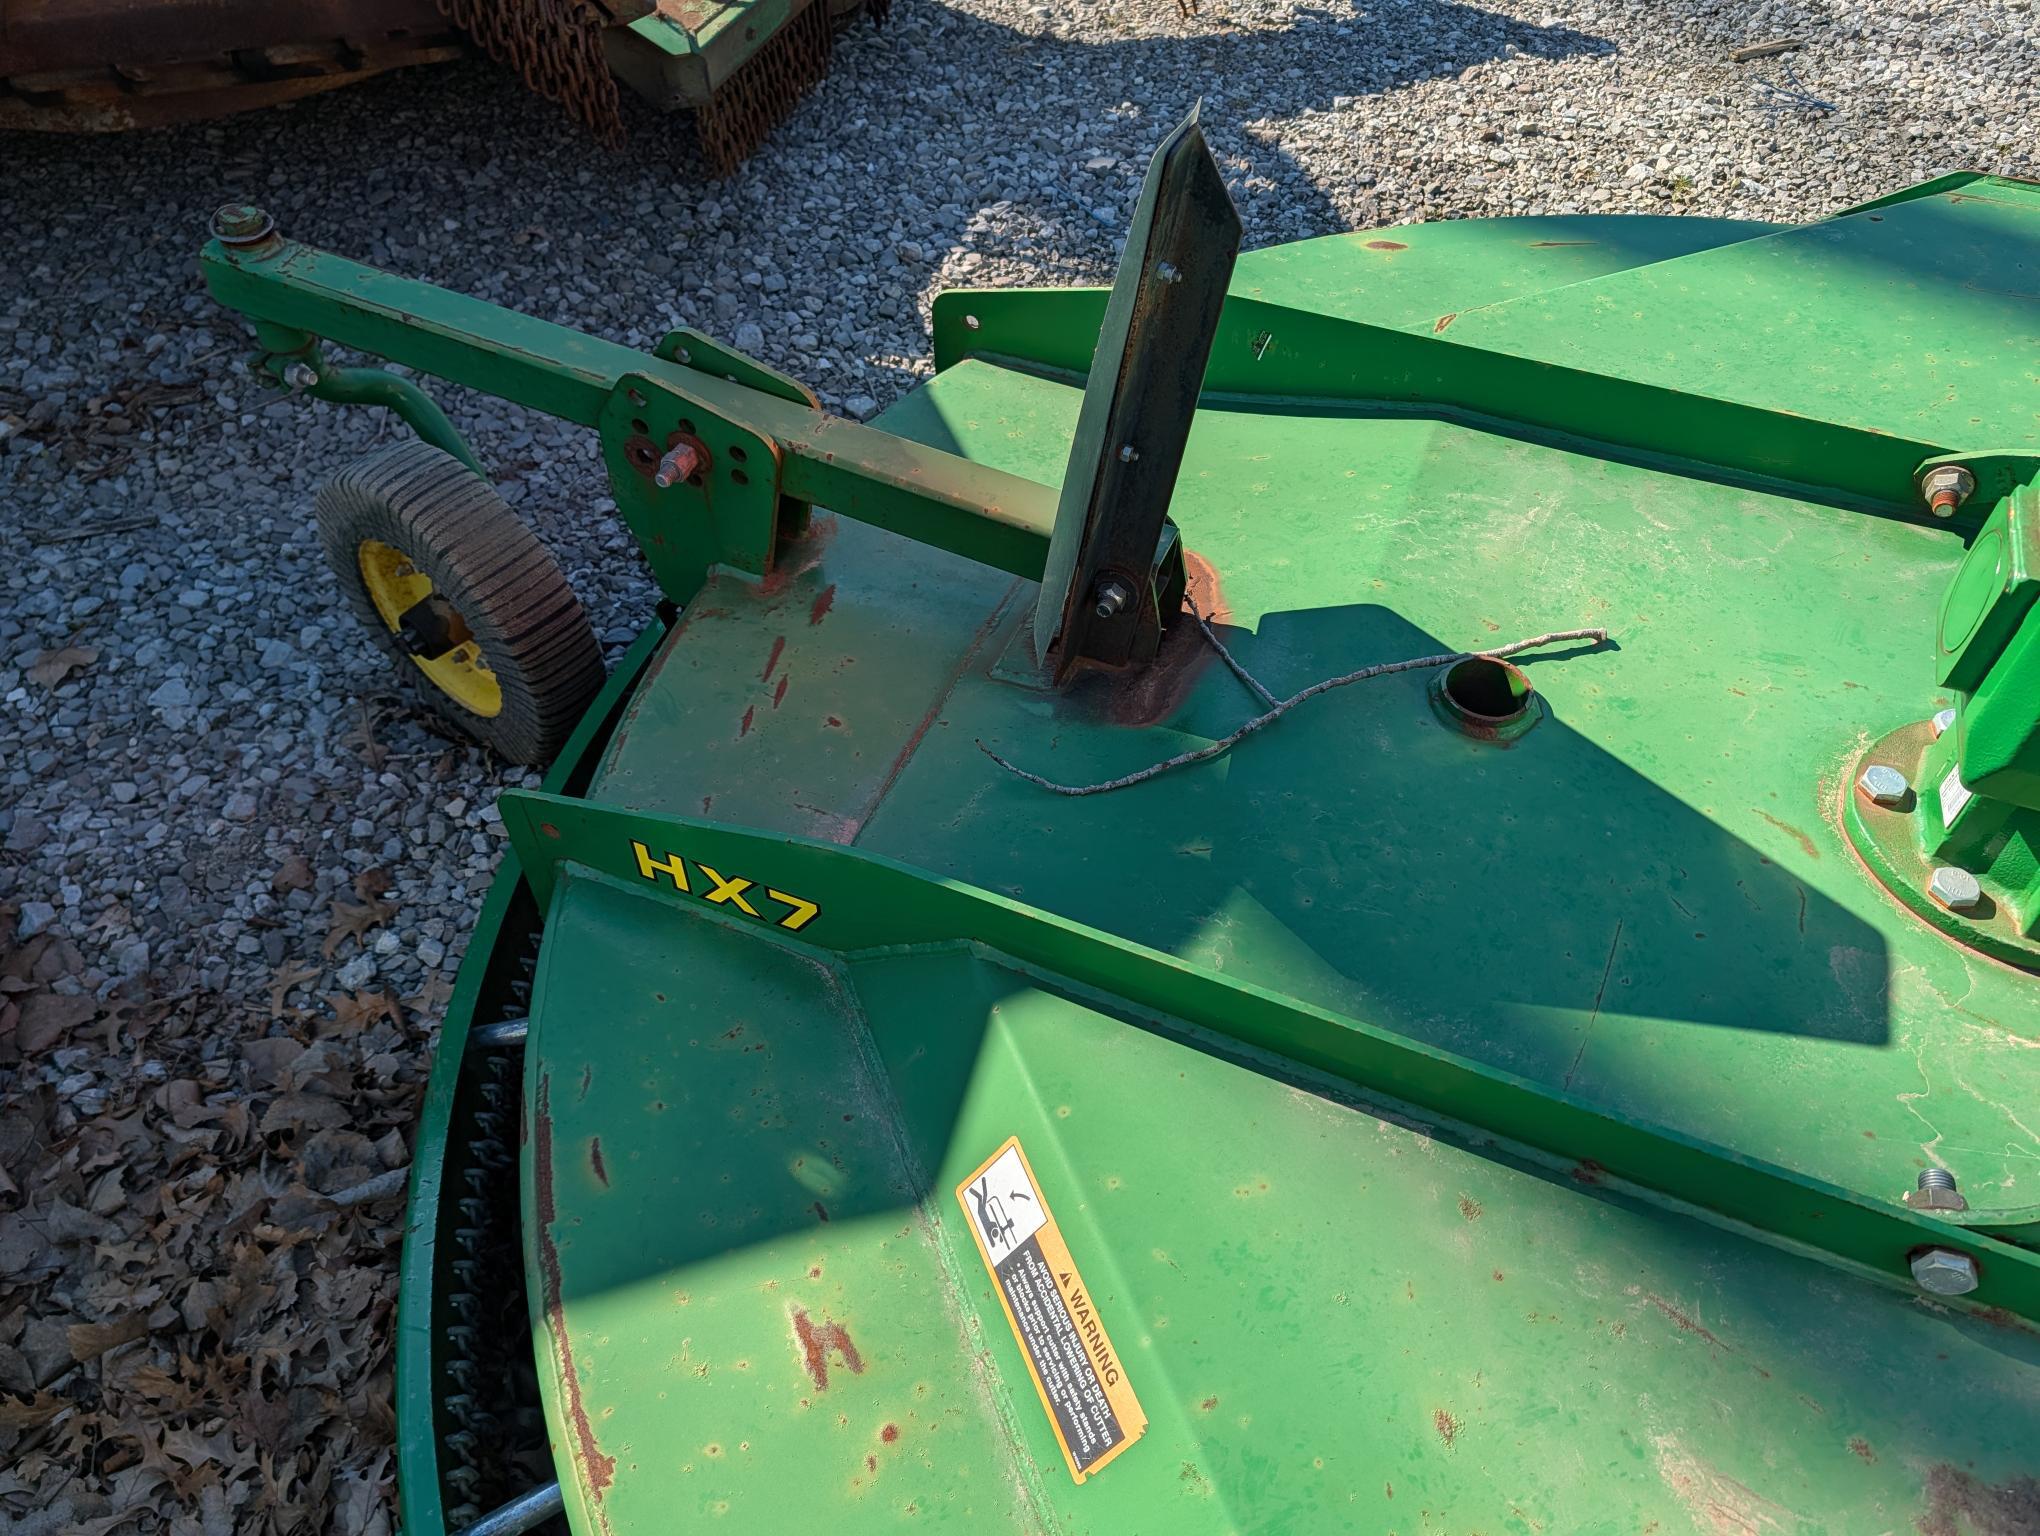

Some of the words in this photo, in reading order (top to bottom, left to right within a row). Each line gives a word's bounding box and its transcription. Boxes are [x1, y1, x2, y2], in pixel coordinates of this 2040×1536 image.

[629, 838, 822, 933] HX7
[1010, 1272, 1019, 1285] or
[1015, 1282, 1032, 1313] blocks
[1004, 1277, 1031, 1333] maintenance
[1027, 1331, 1043, 1360] under
[1038, 1358, 1050, 1376] the
[1045, 1374, 1062, 1407] cutter.
[1021, 1248, 1039, 1279] FROM
[1033, 1276, 1064, 1337] ACCIDENTAL
[1059, 1334, 1088, 1390] LOWERING
[1082, 1387, 1094, 1406] OF
[1089, 1403, 1113, 1448] CUTTER
[1027, 1311, 1041, 1336] prior
[1036, 1259, 1054, 1290] AVOID
[1048, 1287, 1073, 1333] SERIOUS
[1067, 1330, 1088, 1368] INJURY
[1083, 1365, 1096, 1384] OR
[1090, 1382, 1111, 1420] DEATH
[1037, 1334, 1046, 1347] to
[1067, 1287, 1121, 1388] WARNING
[1016, 1266, 1035, 1300] Always
[1029, 1297, 1050, 1335] support
[1045, 1332, 1061, 1362] cutter
[1057, 1360, 1071, 1383] with
[1065, 1380, 1083, 1413] safety
[1078, 1410, 1098, 1445] stands
[1040, 1344, 1064, 1390] servicing
[1059, 1387, 1068, 1401] or
[1063, 1399, 1091, 1454] performing
